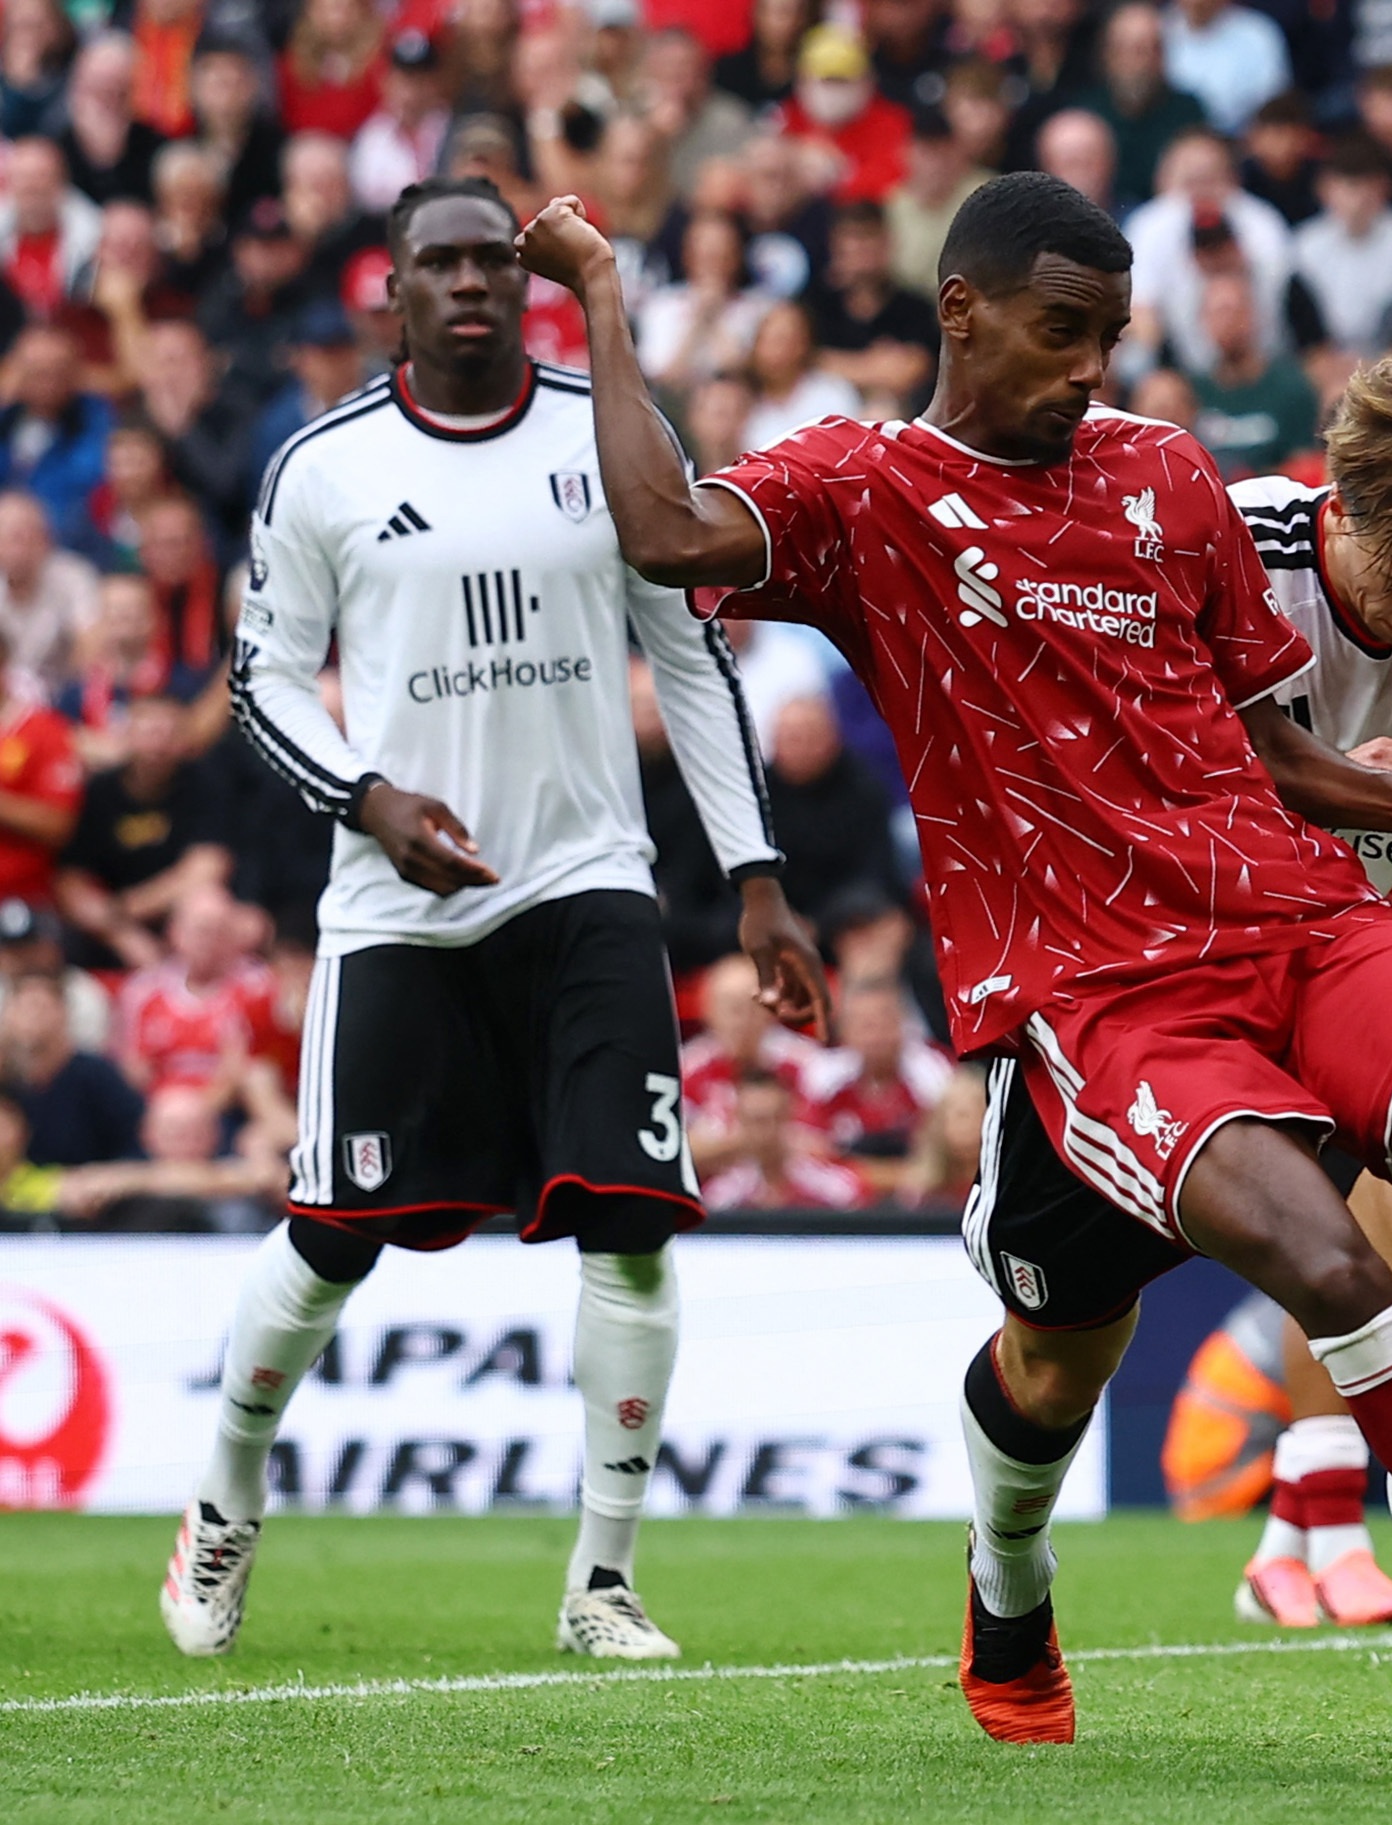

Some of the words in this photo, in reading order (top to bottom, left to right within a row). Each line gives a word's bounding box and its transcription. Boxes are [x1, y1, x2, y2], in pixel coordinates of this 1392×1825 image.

[1134, 540, 1165, 563] LFC
[408, 656, 592, 704] ClickHouse
[637, 1071, 681, 1162] 3
[1157, 1120, 1190, 1161] LFC
[264, 1436, 925, 1507] AIRLNES
